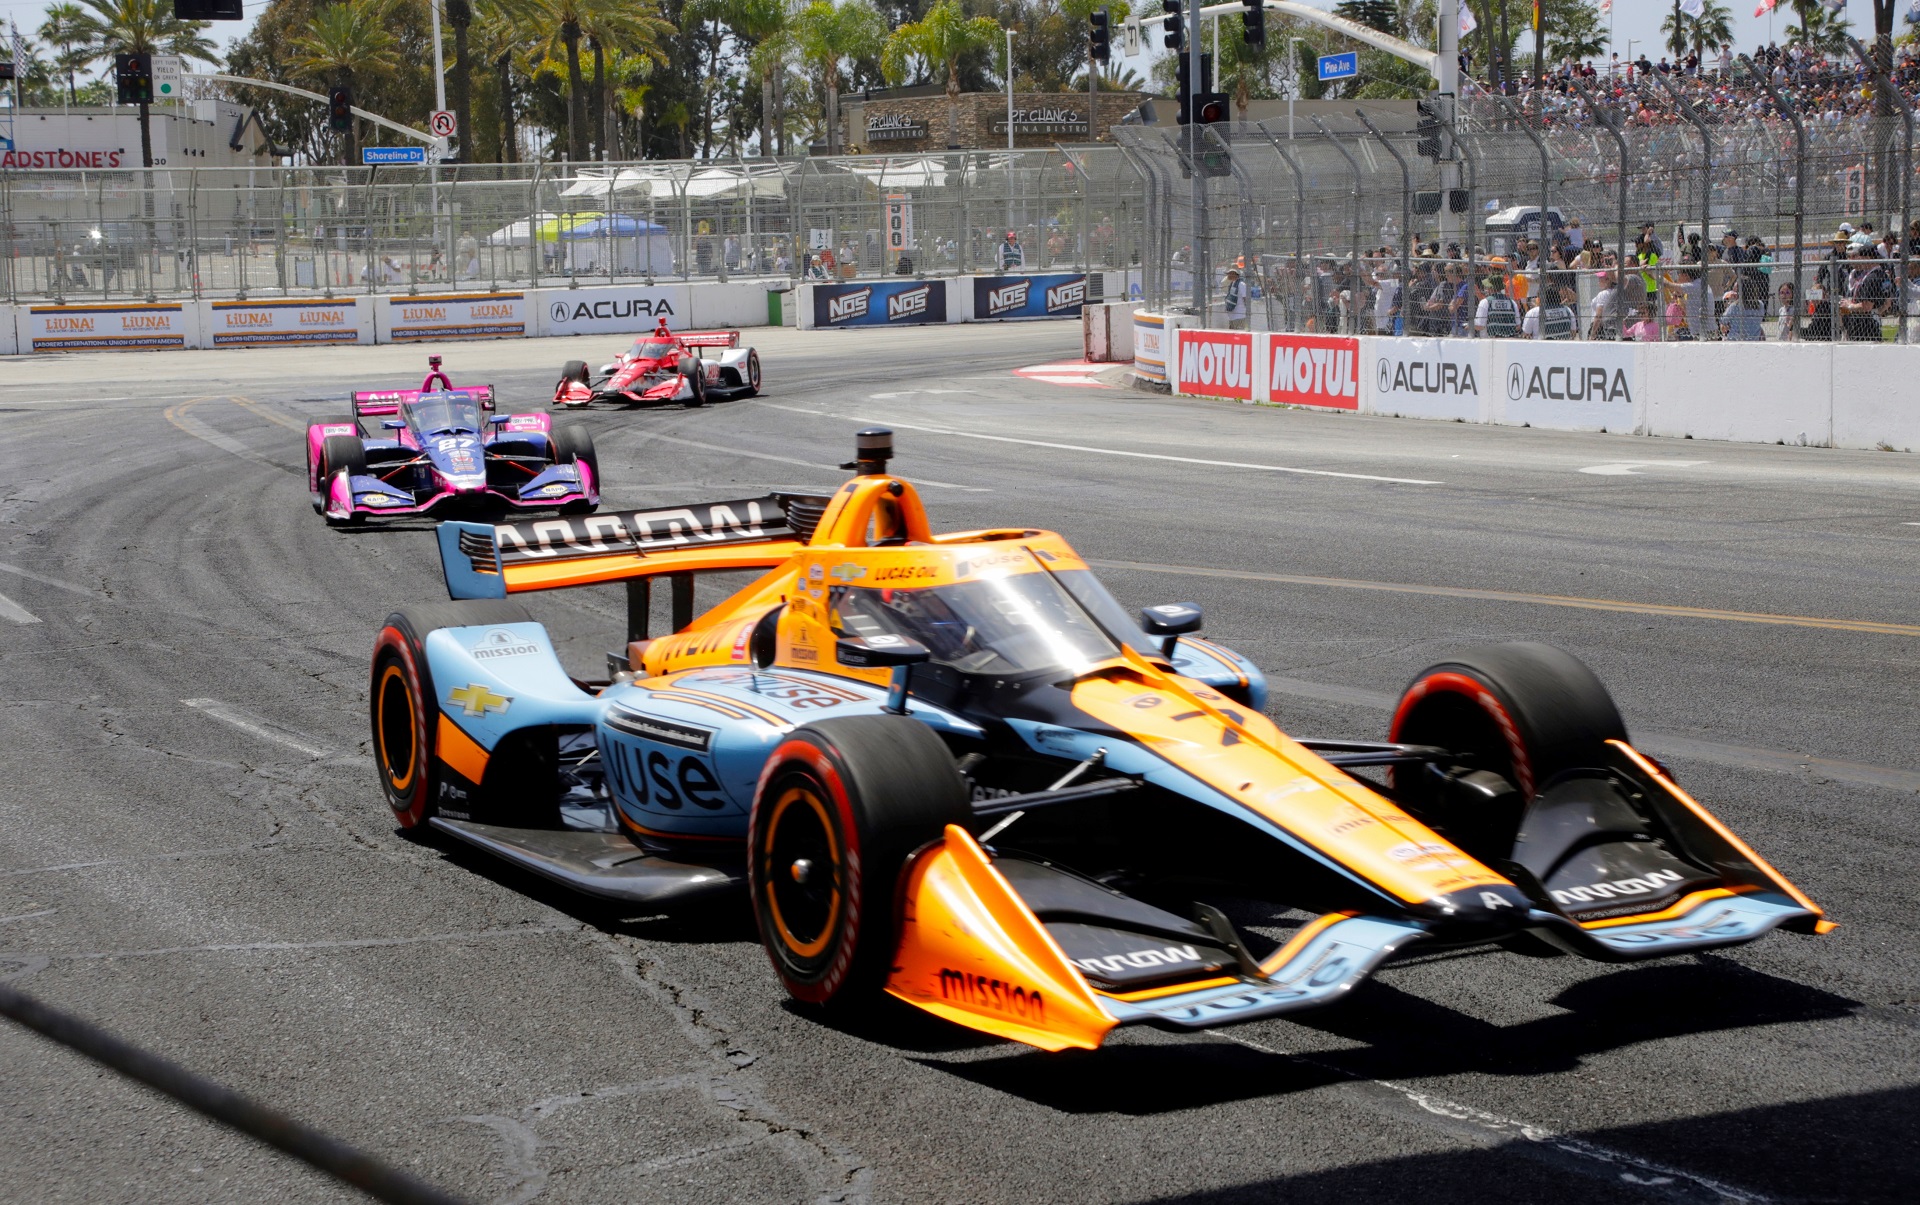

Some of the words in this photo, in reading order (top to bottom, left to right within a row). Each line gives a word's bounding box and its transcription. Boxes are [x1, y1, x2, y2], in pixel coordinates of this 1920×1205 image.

[1324, 62, 1338, 74] Pine
[1338, 60, 1351, 72] Ave
[890, 129, 924, 138] BISTRO
[993, 125, 1038, 133] CHINA
[1046, 125, 1087, 133] BISTRO
[366, 151, 409, 160] Shoreline
[410, 151, 422, 160] Dr
[889, 286, 930, 316] NOS
[989, 281, 1029, 310] NOS
[1047, 279, 1085, 308] NOS
[572, 298, 675, 320] ACURA
[829, 287, 870, 318] NOS
[990, 306, 1010, 315] ENERGY
[1010, 302, 1026, 310] DRINK
[1048, 305, 1067, 313] ENERGY
[1068, 300, 1084, 308] DRINK
[226, 312, 273, 325] LiUNA!
[299, 311, 345, 323] LiUNA!
[403, 307, 447, 319] LiUNA!
[470, 304, 513, 317] LiUNA!
[830, 313, 851, 323] ENERGY
[851, 309, 867, 318] DRINK
[890, 311, 910, 320] ENERGY
[910, 307, 927, 316] DRINK
[45, 317, 95, 330] LiUNA!
[121, 315, 171, 328] LiUNA!
[1180, 341, 1251, 388] MOTUL
[1271, 346, 1357, 397] MOTUL
[1393, 361, 1479, 396] ACURA
[1526, 366, 1632, 403] ACURA
[874, 565, 915, 581] LUCAS
[602, 732, 726, 811] vuse
[1549, 868, 1684, 905] ARROW
